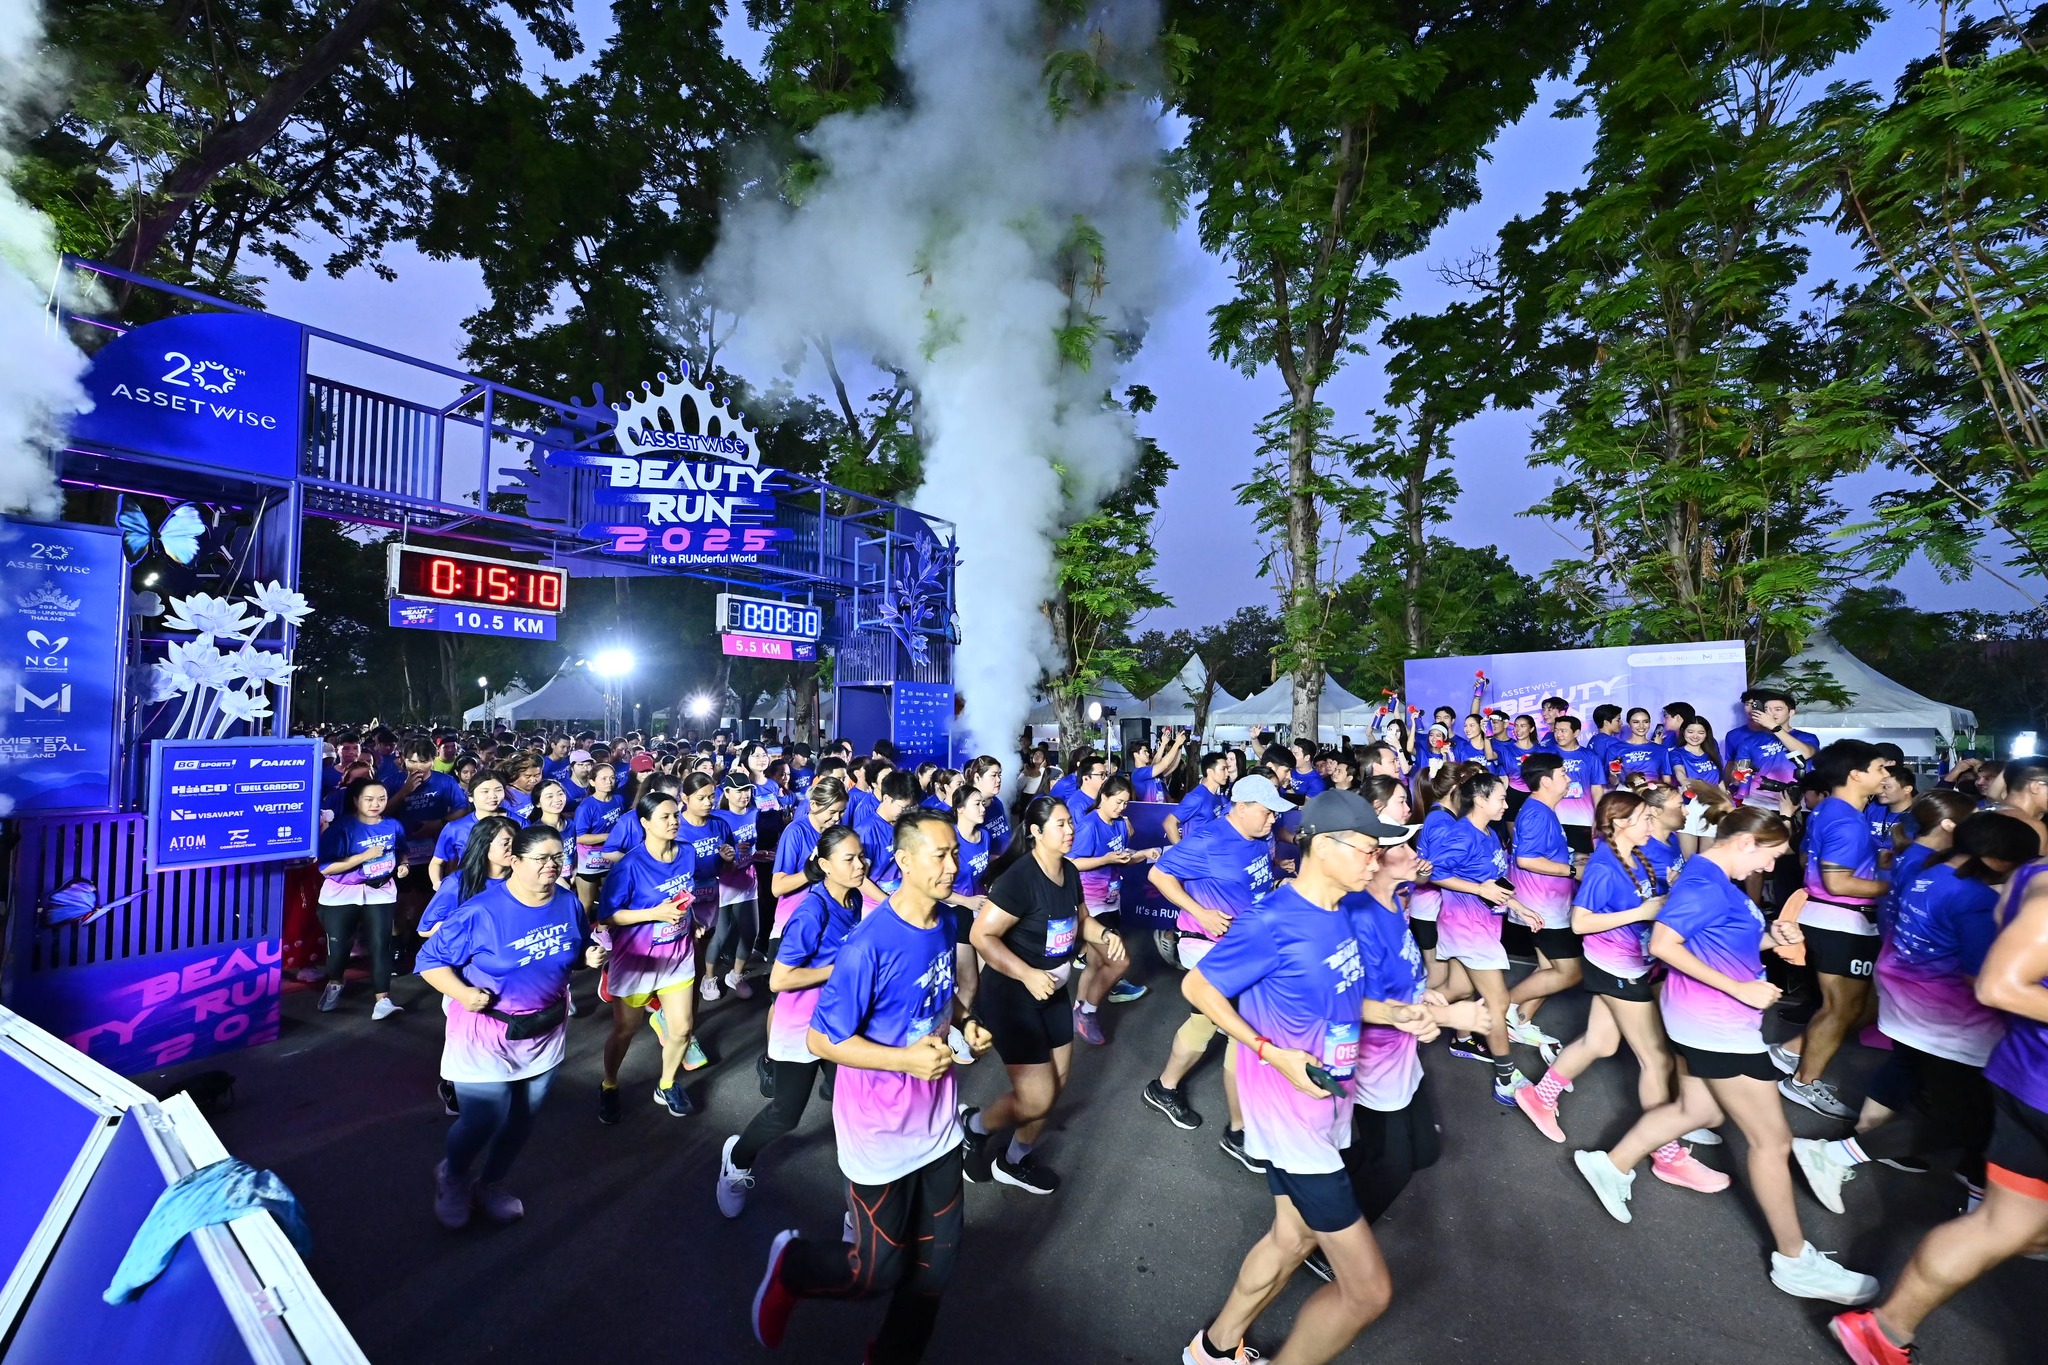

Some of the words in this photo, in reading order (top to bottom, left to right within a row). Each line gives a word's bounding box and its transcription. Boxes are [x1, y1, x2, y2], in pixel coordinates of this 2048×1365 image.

[600, 458, 778, 493] BEAUTY
[644, 491, 740, 527] RUN
[604, 526, 776, 552] 2025
[651, 554, 667, 564] It's
[669, 556, 676, 564] a
[678, 554, 728, 564] RUNderful
[730, 554, 757, 563] World
[432, 560, 559, 607] 0:15:10
[455, 612, 504, 630] 10.5
[514, 617, 544, 634] KM
[744, 603, 818, 636] 0:00:10
[735, 640, 757, 653] 5.5
[762, 642, 781, 655] KM
[25, 655, 68, 667] NCI
[0, 736, 67, 744] MISTER
[0, 743, 86, 753] GLBAL
[261, 759, 306, 767] DAIKIN
[241, 784, 262, 792] WELL
[262, 783, 300, 791] GRADED
[197, 810, 245, 819] VISAVAPAT
[253, 802, 304, 812] warmer
[169, 834, 206, 849] ATOM
[1136, 905, 1150, 915] It's
[1151, 909, 1158, 917] a
[505, 922, 569, 951] BEAUTY
[523, 935, 562, 955] RUN
[515, 942, 572, 967] 2025
[1850, 958, 1874, 977] GO
